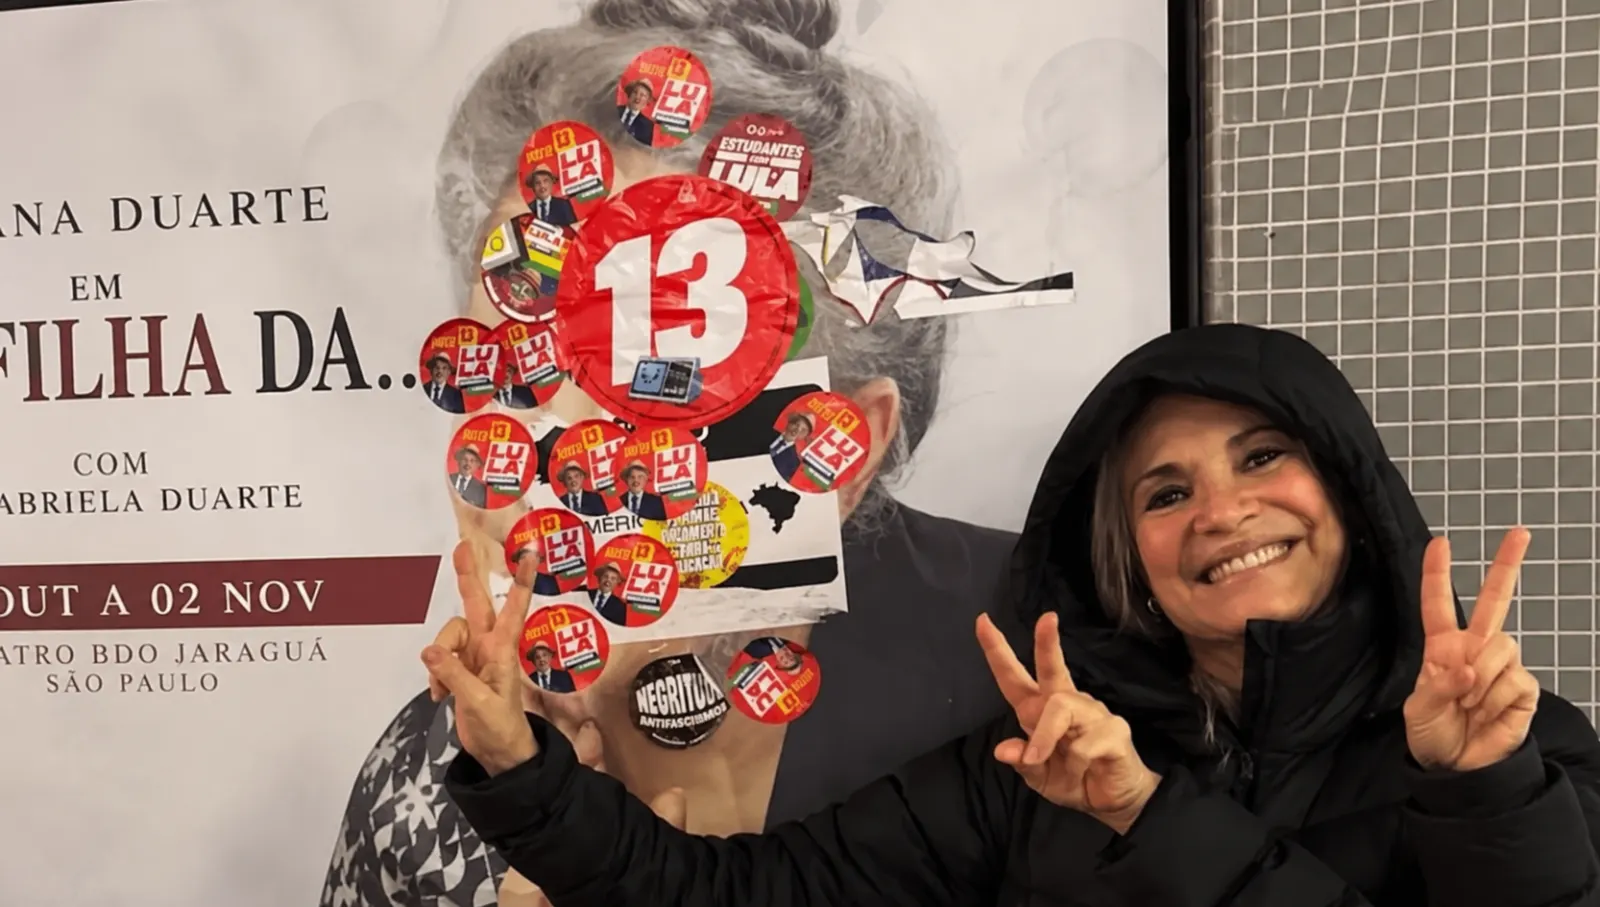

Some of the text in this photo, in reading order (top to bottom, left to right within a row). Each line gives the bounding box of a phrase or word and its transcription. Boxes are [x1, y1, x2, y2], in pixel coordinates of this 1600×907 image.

[560, 144, 594, 169] LU
[719, 136, 805, 159] ESTUDANTES
[562, 161, 598, 186] LA
[0, 186, 329, 237] NA DUARTE
[70, 274, 122, 301] EM
[594, 217, 748, 387] 13
[460, 346, 494, 362] LU
[516, 336, 547, 360] LU
[459, 362, 490, 377] LA
[520, 351, 553, 375] LA
[490, 444, 525, 459] LU
[657, 447, 690, 468] LU
[73, 451, 148, 476] COM
[486, 459, 519, 475] LA
[657, 464, 692, 484] LA
[0, 484, 303, 515] ABRIELA DUARTE
[547, 529, 578, 550] LU
[549, 544, 581, 564] LA
[632, 563, 667, 580] LU
[100, 584, 130, 616] A
[151, 582, 200, 615] 02
[223, 580, 325, 613] NOV
[627, 578, 660, 595] LA
[557, 622, 589, 644] LU
[92, 643, 158, 664] BDO
[175, 637, 328, 666] JARAGUÁ
[560, 636, 594, 659] LA
[47, 670, 219, 693] SÃO PAULO
